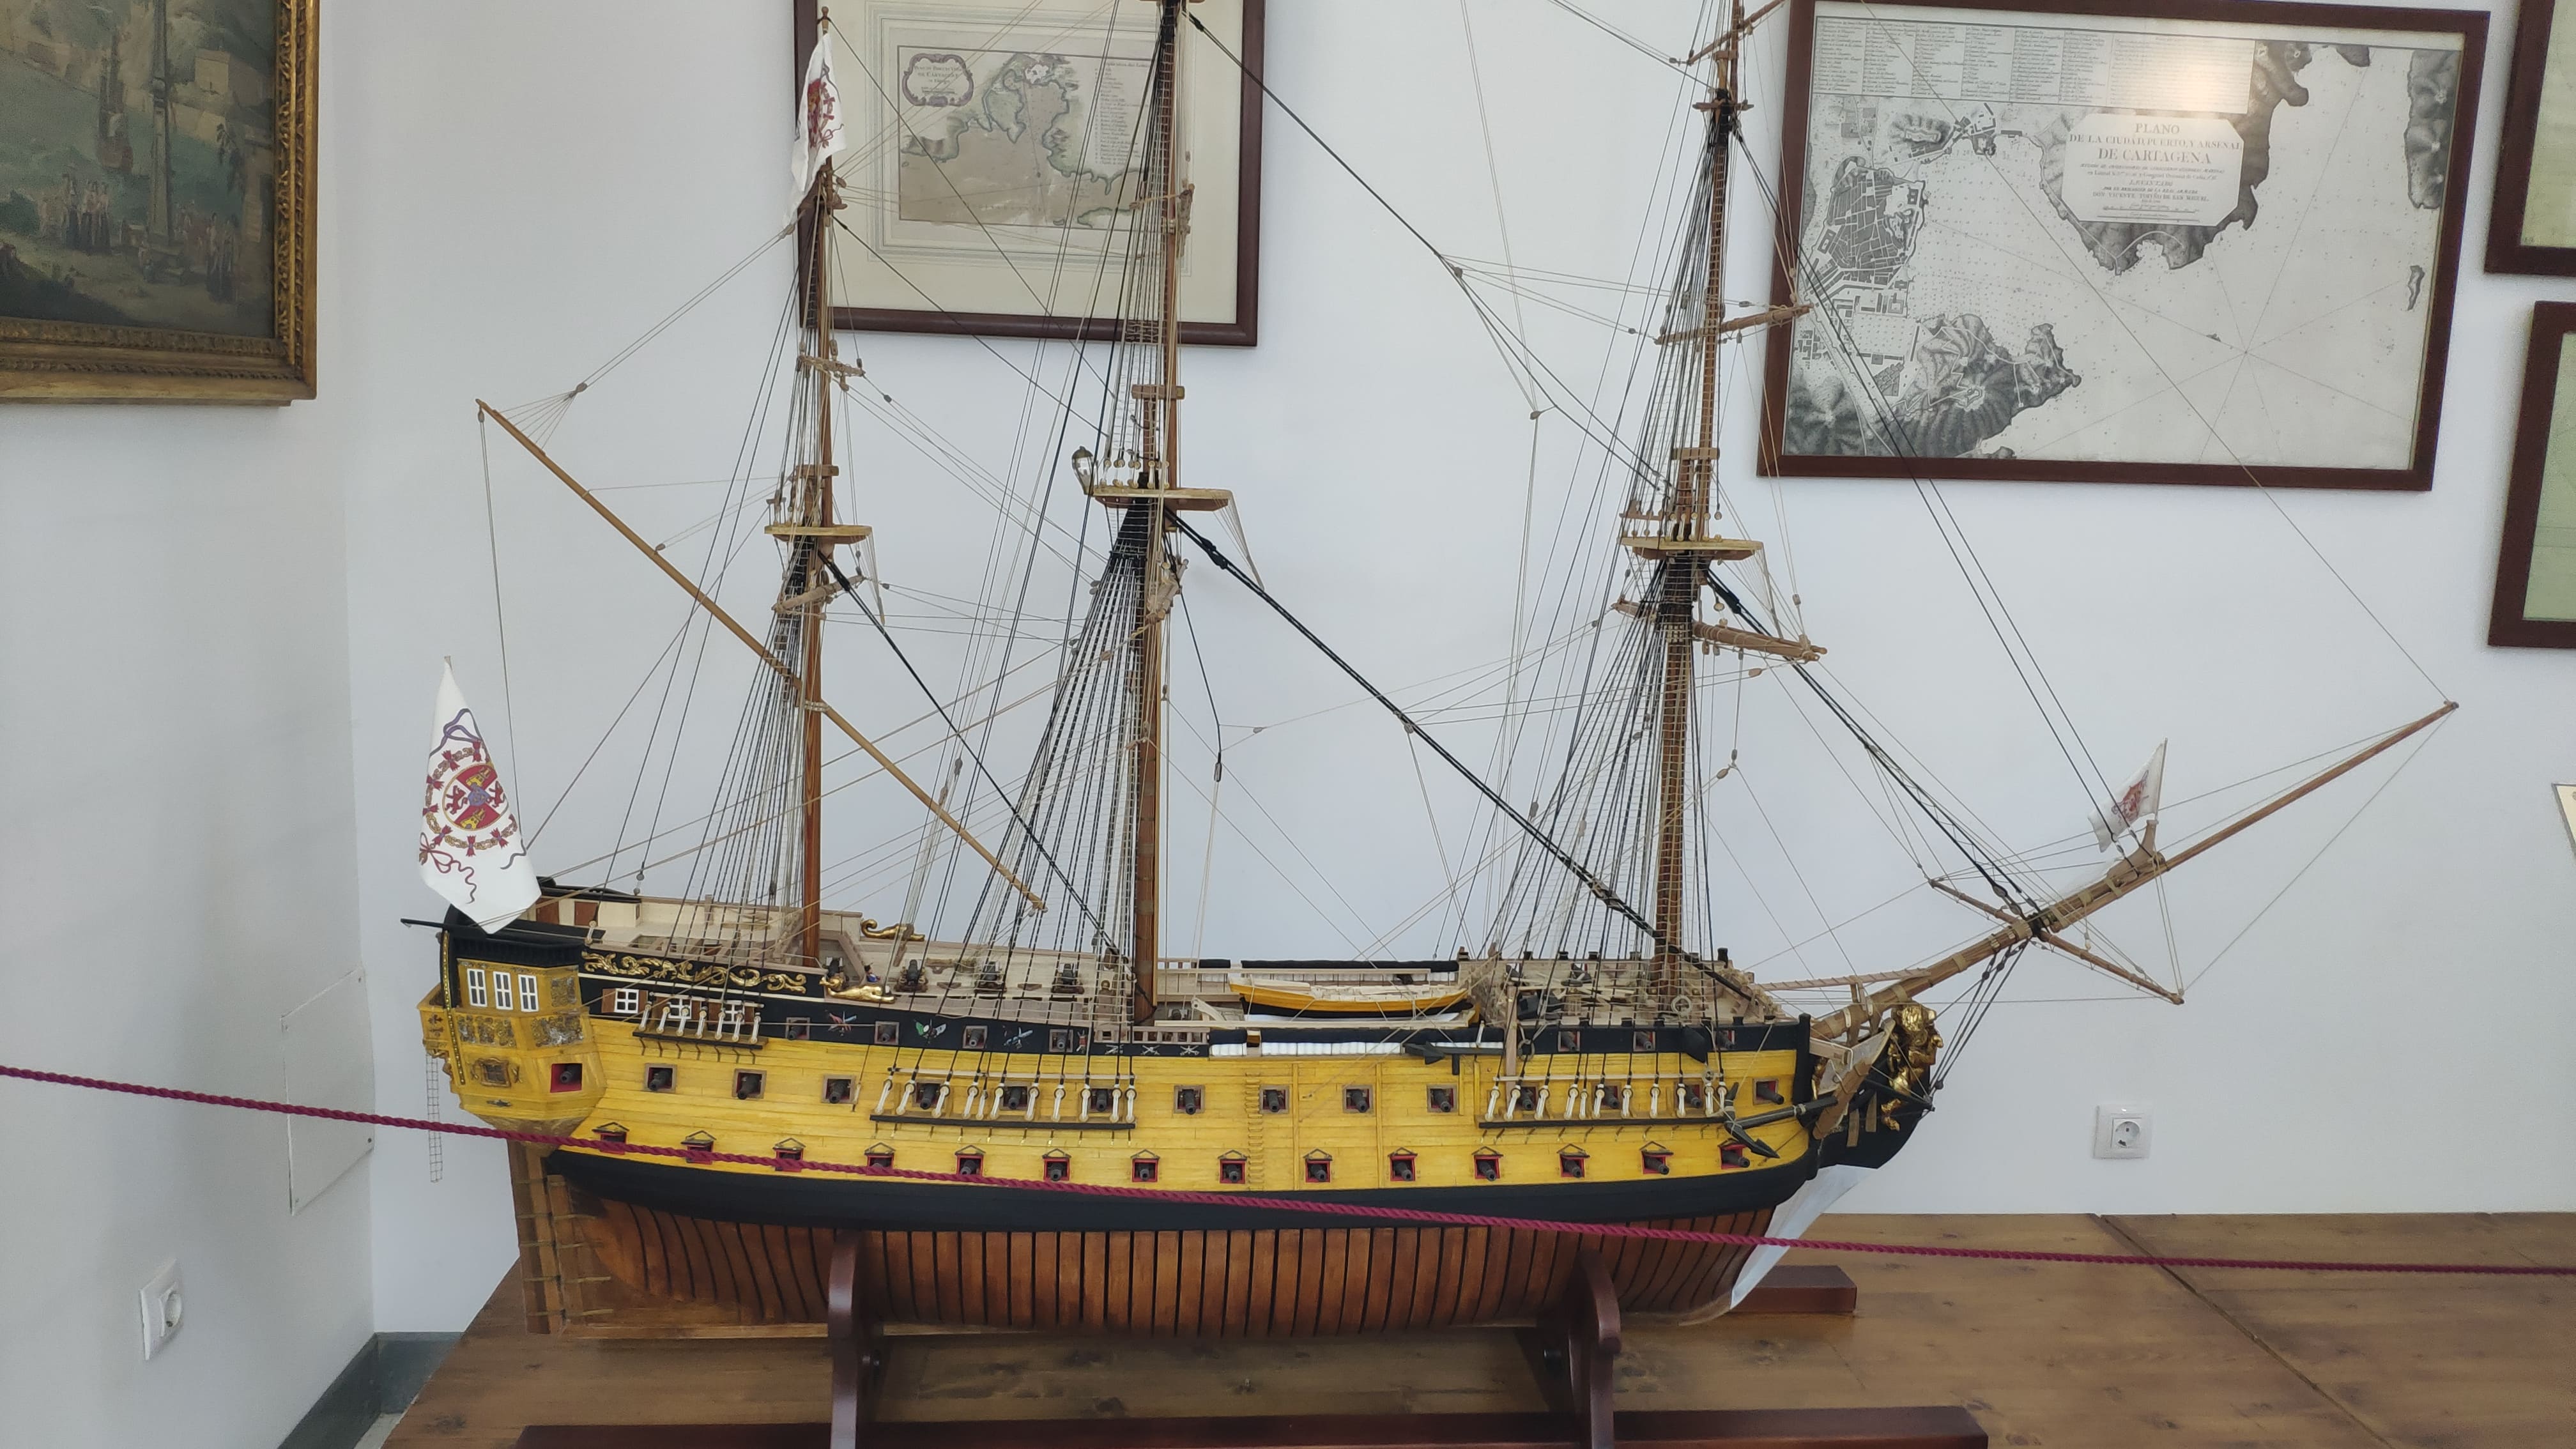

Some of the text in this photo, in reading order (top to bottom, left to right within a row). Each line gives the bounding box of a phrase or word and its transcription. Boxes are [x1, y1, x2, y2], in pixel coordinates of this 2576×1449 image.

[2135, 123, 2180, 134] PLANO
[2069, 134, 2085, 142] DE
[2088, 135, 2102, 143] LA
[2098, 148, 2212, 164] DE CARTAGENA
